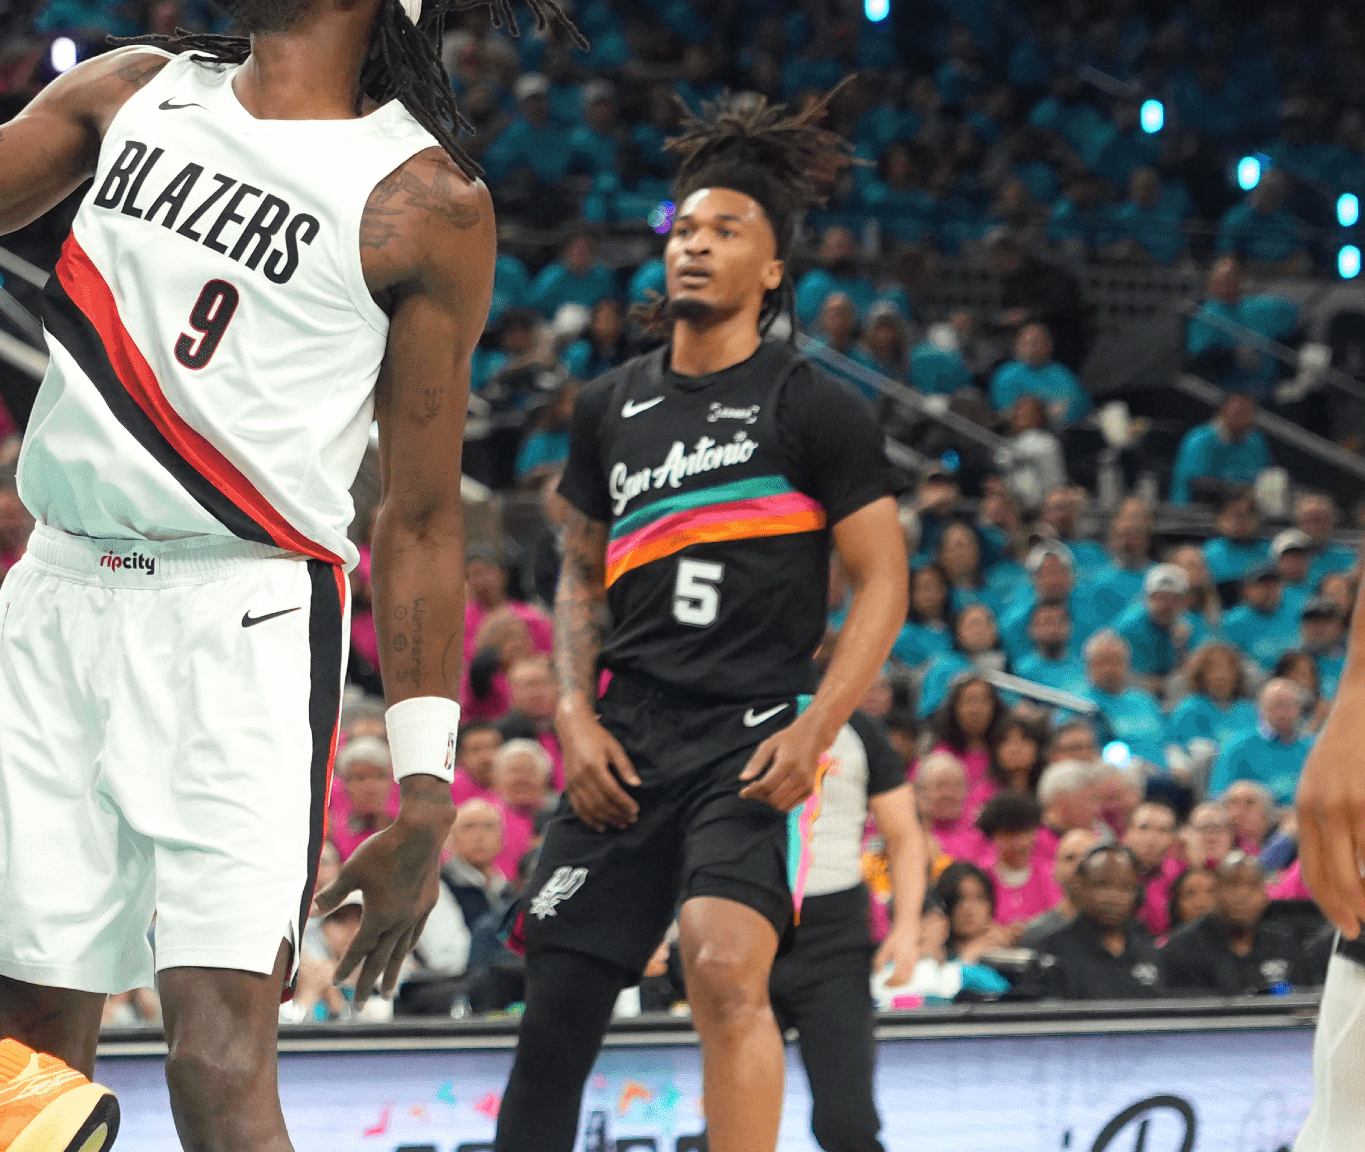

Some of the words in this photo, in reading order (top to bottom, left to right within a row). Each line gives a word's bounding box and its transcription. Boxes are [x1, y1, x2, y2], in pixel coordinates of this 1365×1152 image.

[93, 140, 320, 284] BLAZERS
[174, 278, 240, 371] 9
[609, 462, 653, 516] San
[651, 430, 759, 490] Antonio
[100, 550, 156, 575] ripcity
[672, 556, 726, 628] 5
